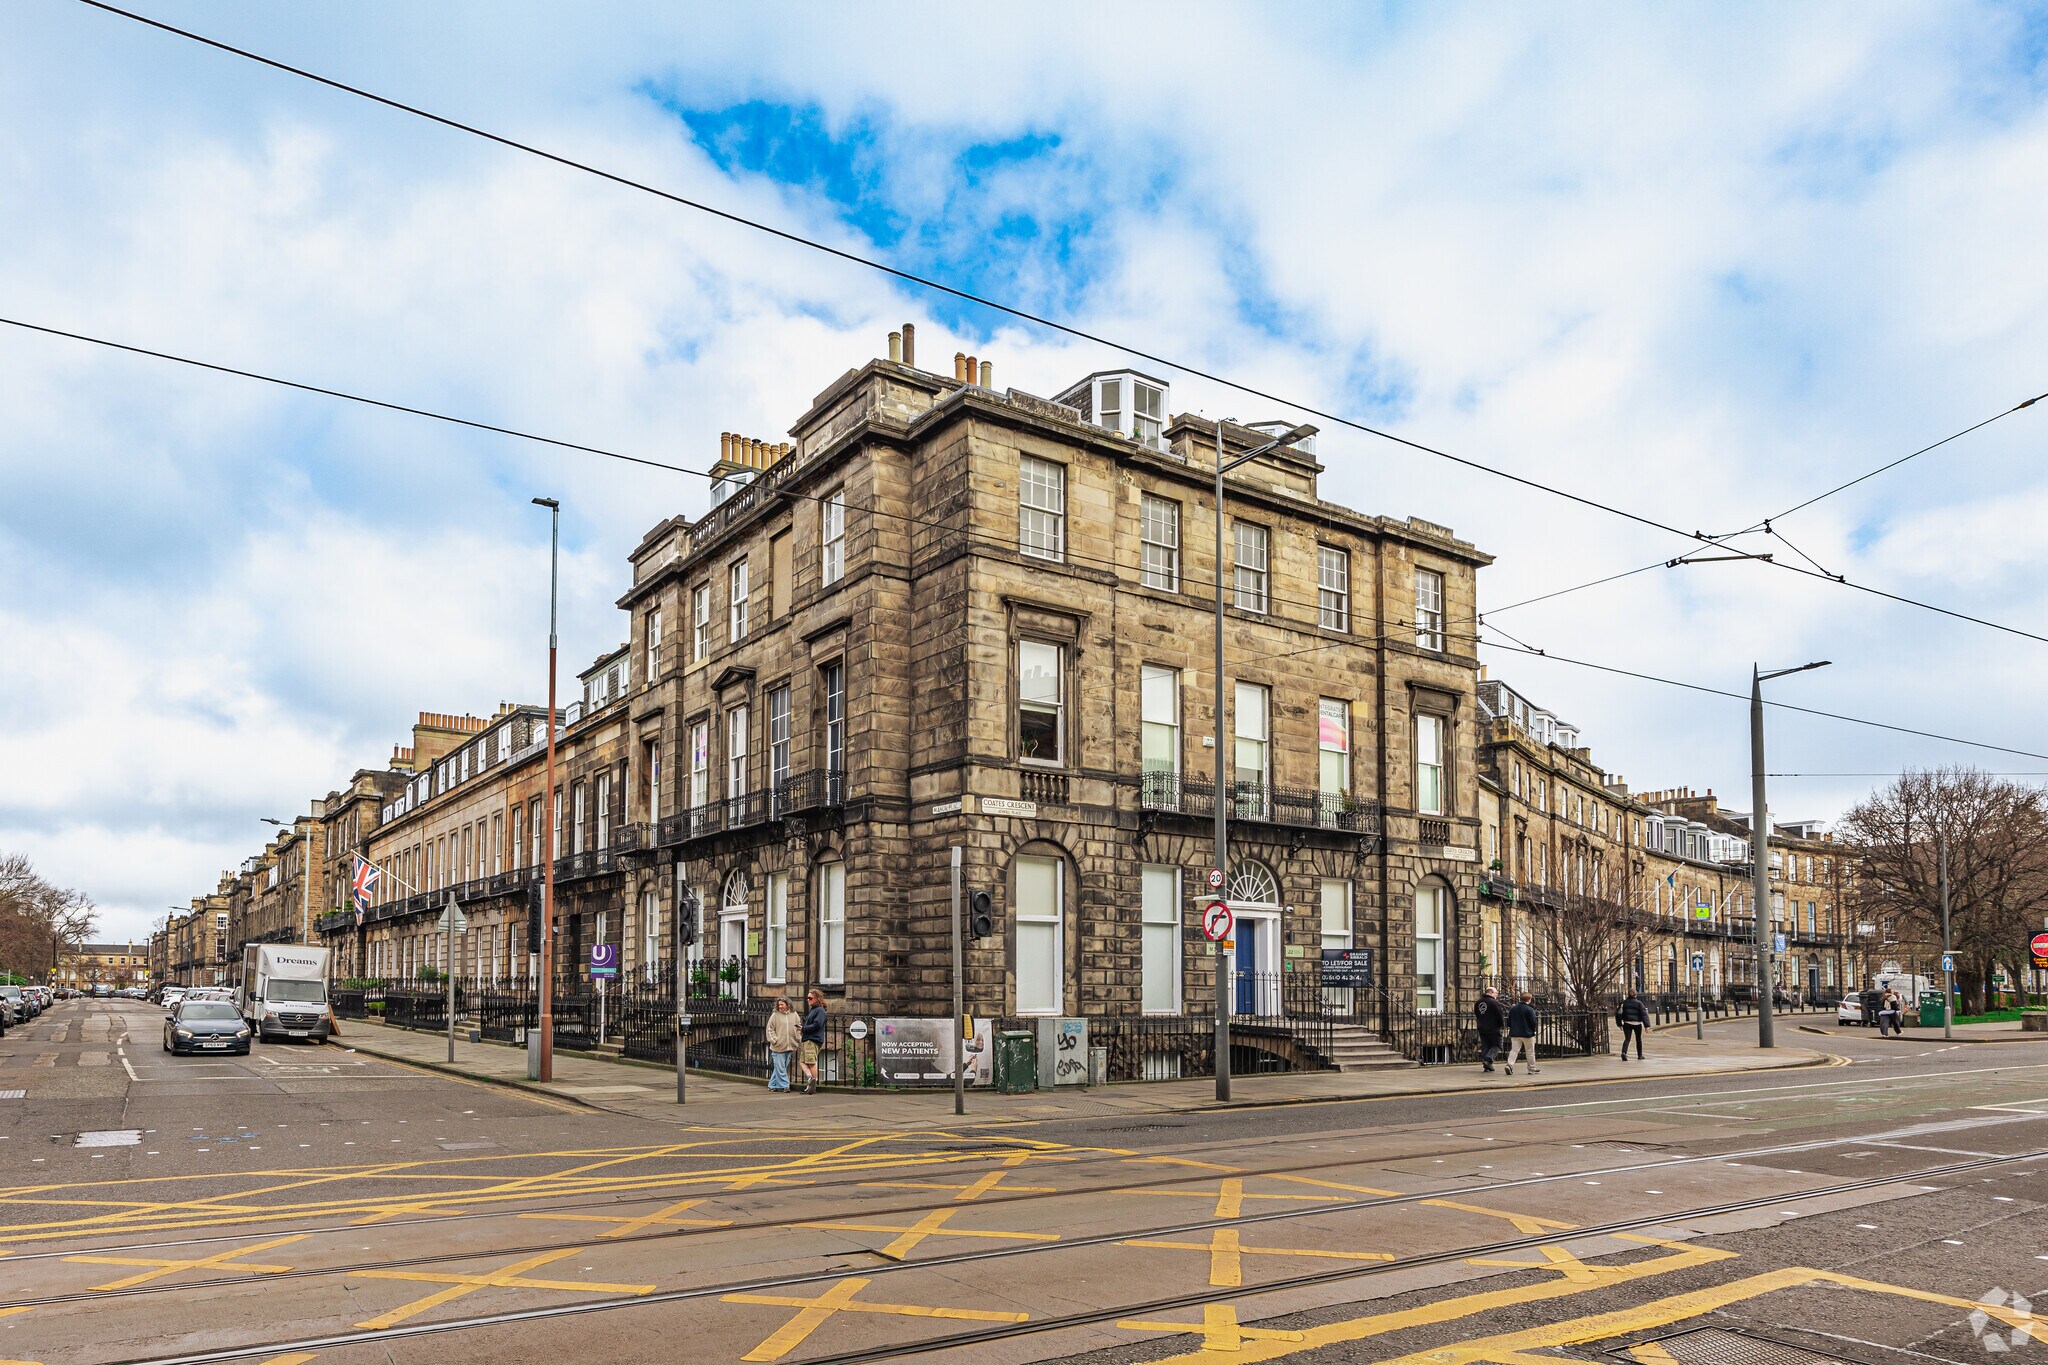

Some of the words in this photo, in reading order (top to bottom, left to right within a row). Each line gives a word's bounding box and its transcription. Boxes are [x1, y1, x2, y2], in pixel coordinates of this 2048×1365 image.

[984, 799, 1005, 807] COATES
[1007, 802, 1035, 810] CRESCENT
[1211, 874, 1220, 882] 20
[276, 956, 317, 966] Dreams
